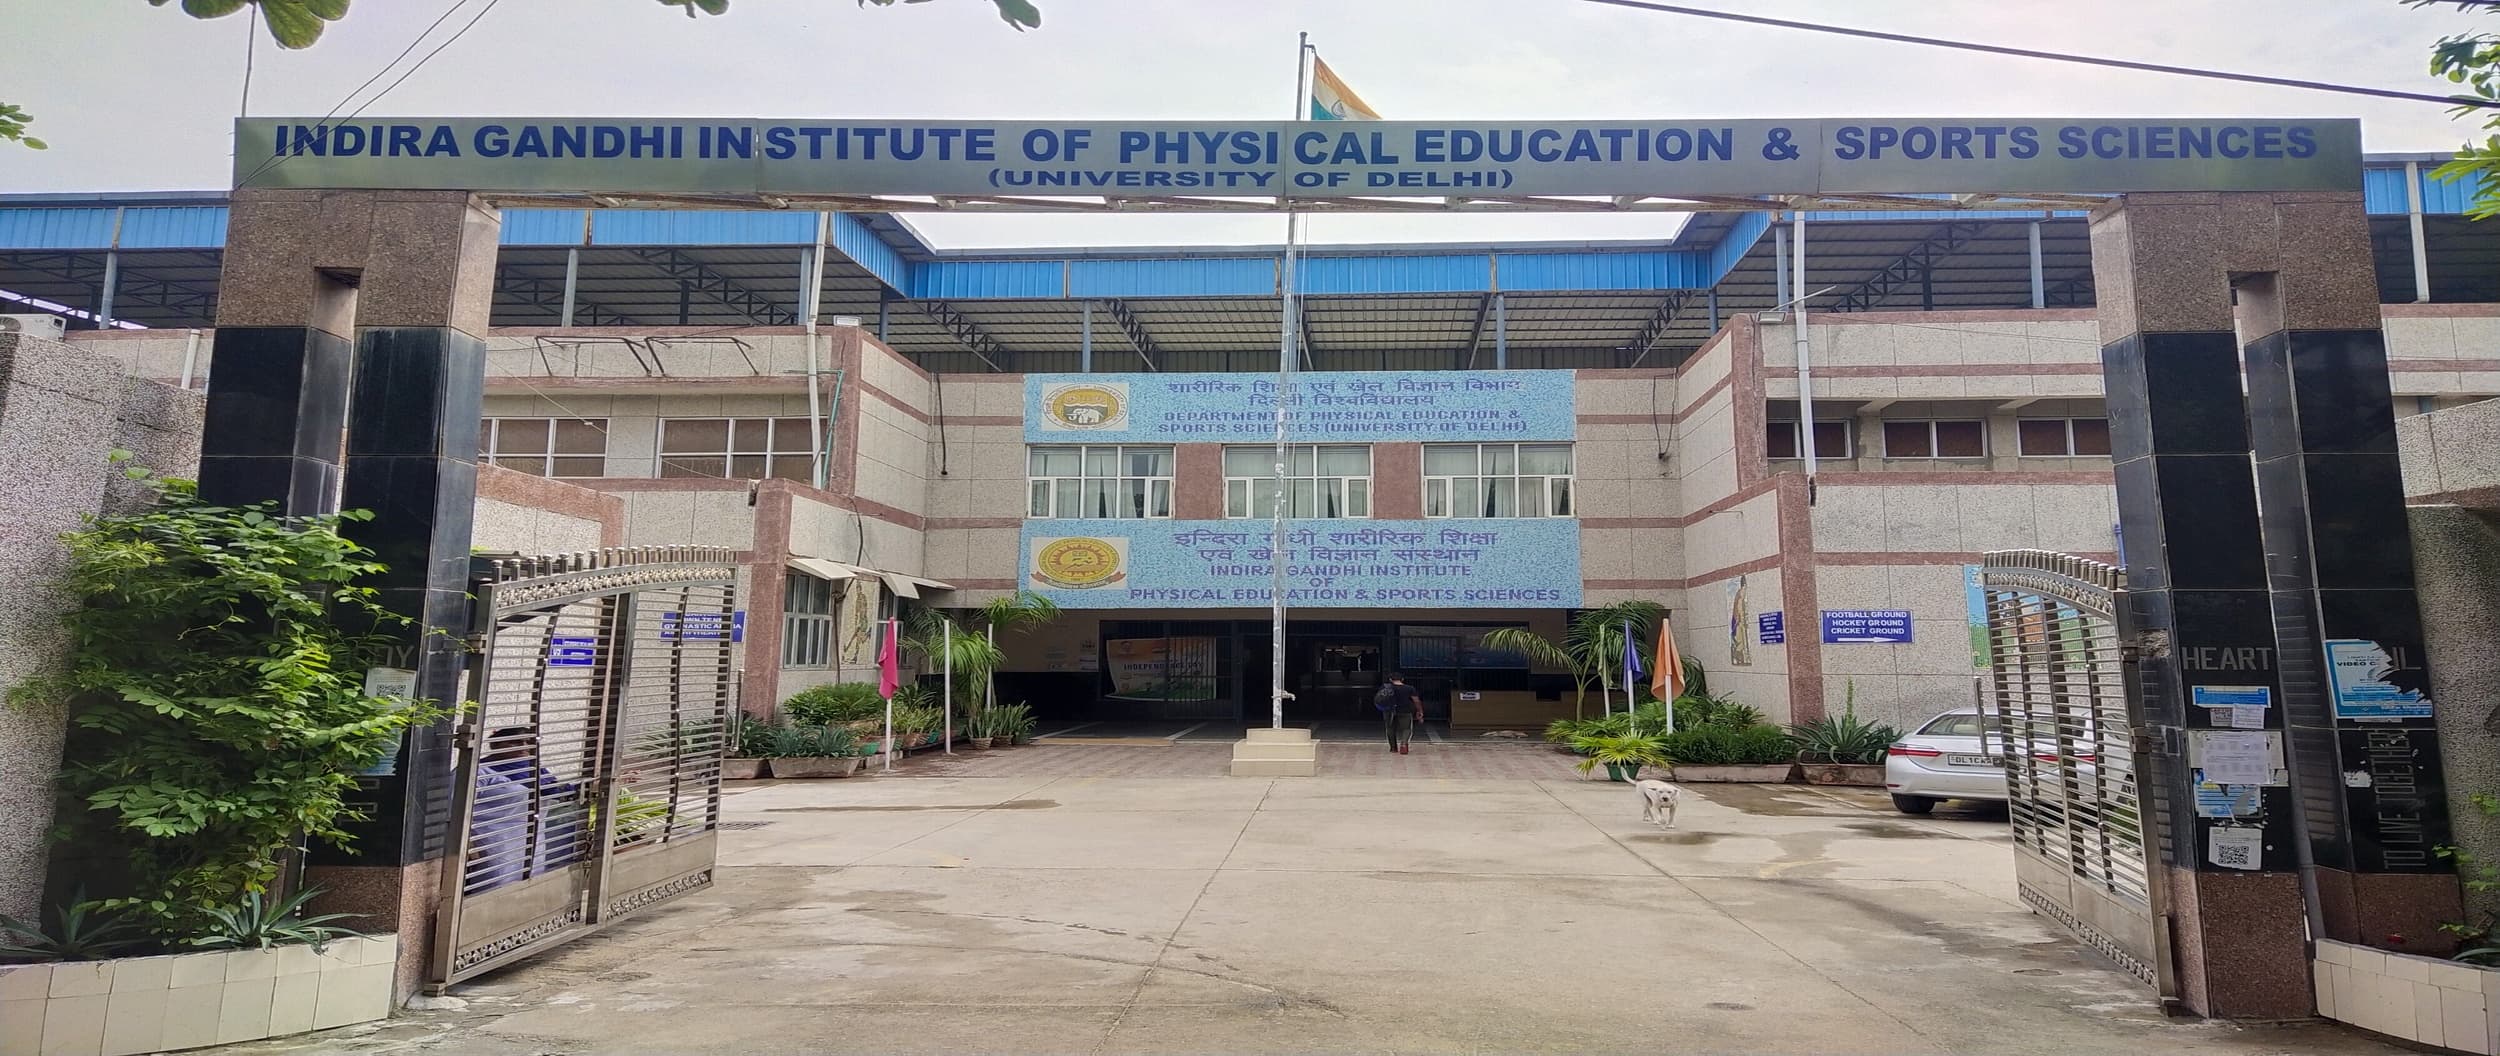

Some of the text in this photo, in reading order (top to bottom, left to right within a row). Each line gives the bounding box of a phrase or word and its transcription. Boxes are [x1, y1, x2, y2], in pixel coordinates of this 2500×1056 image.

[275, 125, 461, 157] INDIRA
[473, 126, 683, 158] GANDHI
[1022, 128, 1091, 162] OF
[1415, 127, 1735, 163] EDUCATION
[1761, 127, 1800, 162] &
[1834, 126, 2040, 160] SPORTS
[2057, 125, 2318, 160] SCIENCES
[988, 169, 1514, 189] (UNIVERSITY OF DELHI)
[1166, 380, 1242, 393] शारीरिक
[1164, 411, 1280, 421] DEPARTMENT
[1310, 410, 1394, 420] PHYSICAL
[1402, 410, 1500, 419] EDUCATION
[1508, 410, 1520, 419] &
[1158, 423, 1227, 433] SPORTS
[1439, 421, 1460, 432] OF
[1328, 528, 1426, 546] शारीरिक
[1439, 528, 1498, 546] शिक्षा
[1308, 546, 1381, 561] विज्ञान
[1391, 546, 1480, 561] संस्थान
[1210, 564, 1472, 576] INDIRA GANDHI INSTITUTE
[1309, 577, 1335, 588] OF
[1130, 588, 1560, 601] PHYSICAL EDUATION & SPORTS SCIENCES
[1826, 611, 1870, 619] FOOTBALL
[1869, 627, 1905, 635] GROUND
[2181, 646, 2273, 671] HEART
